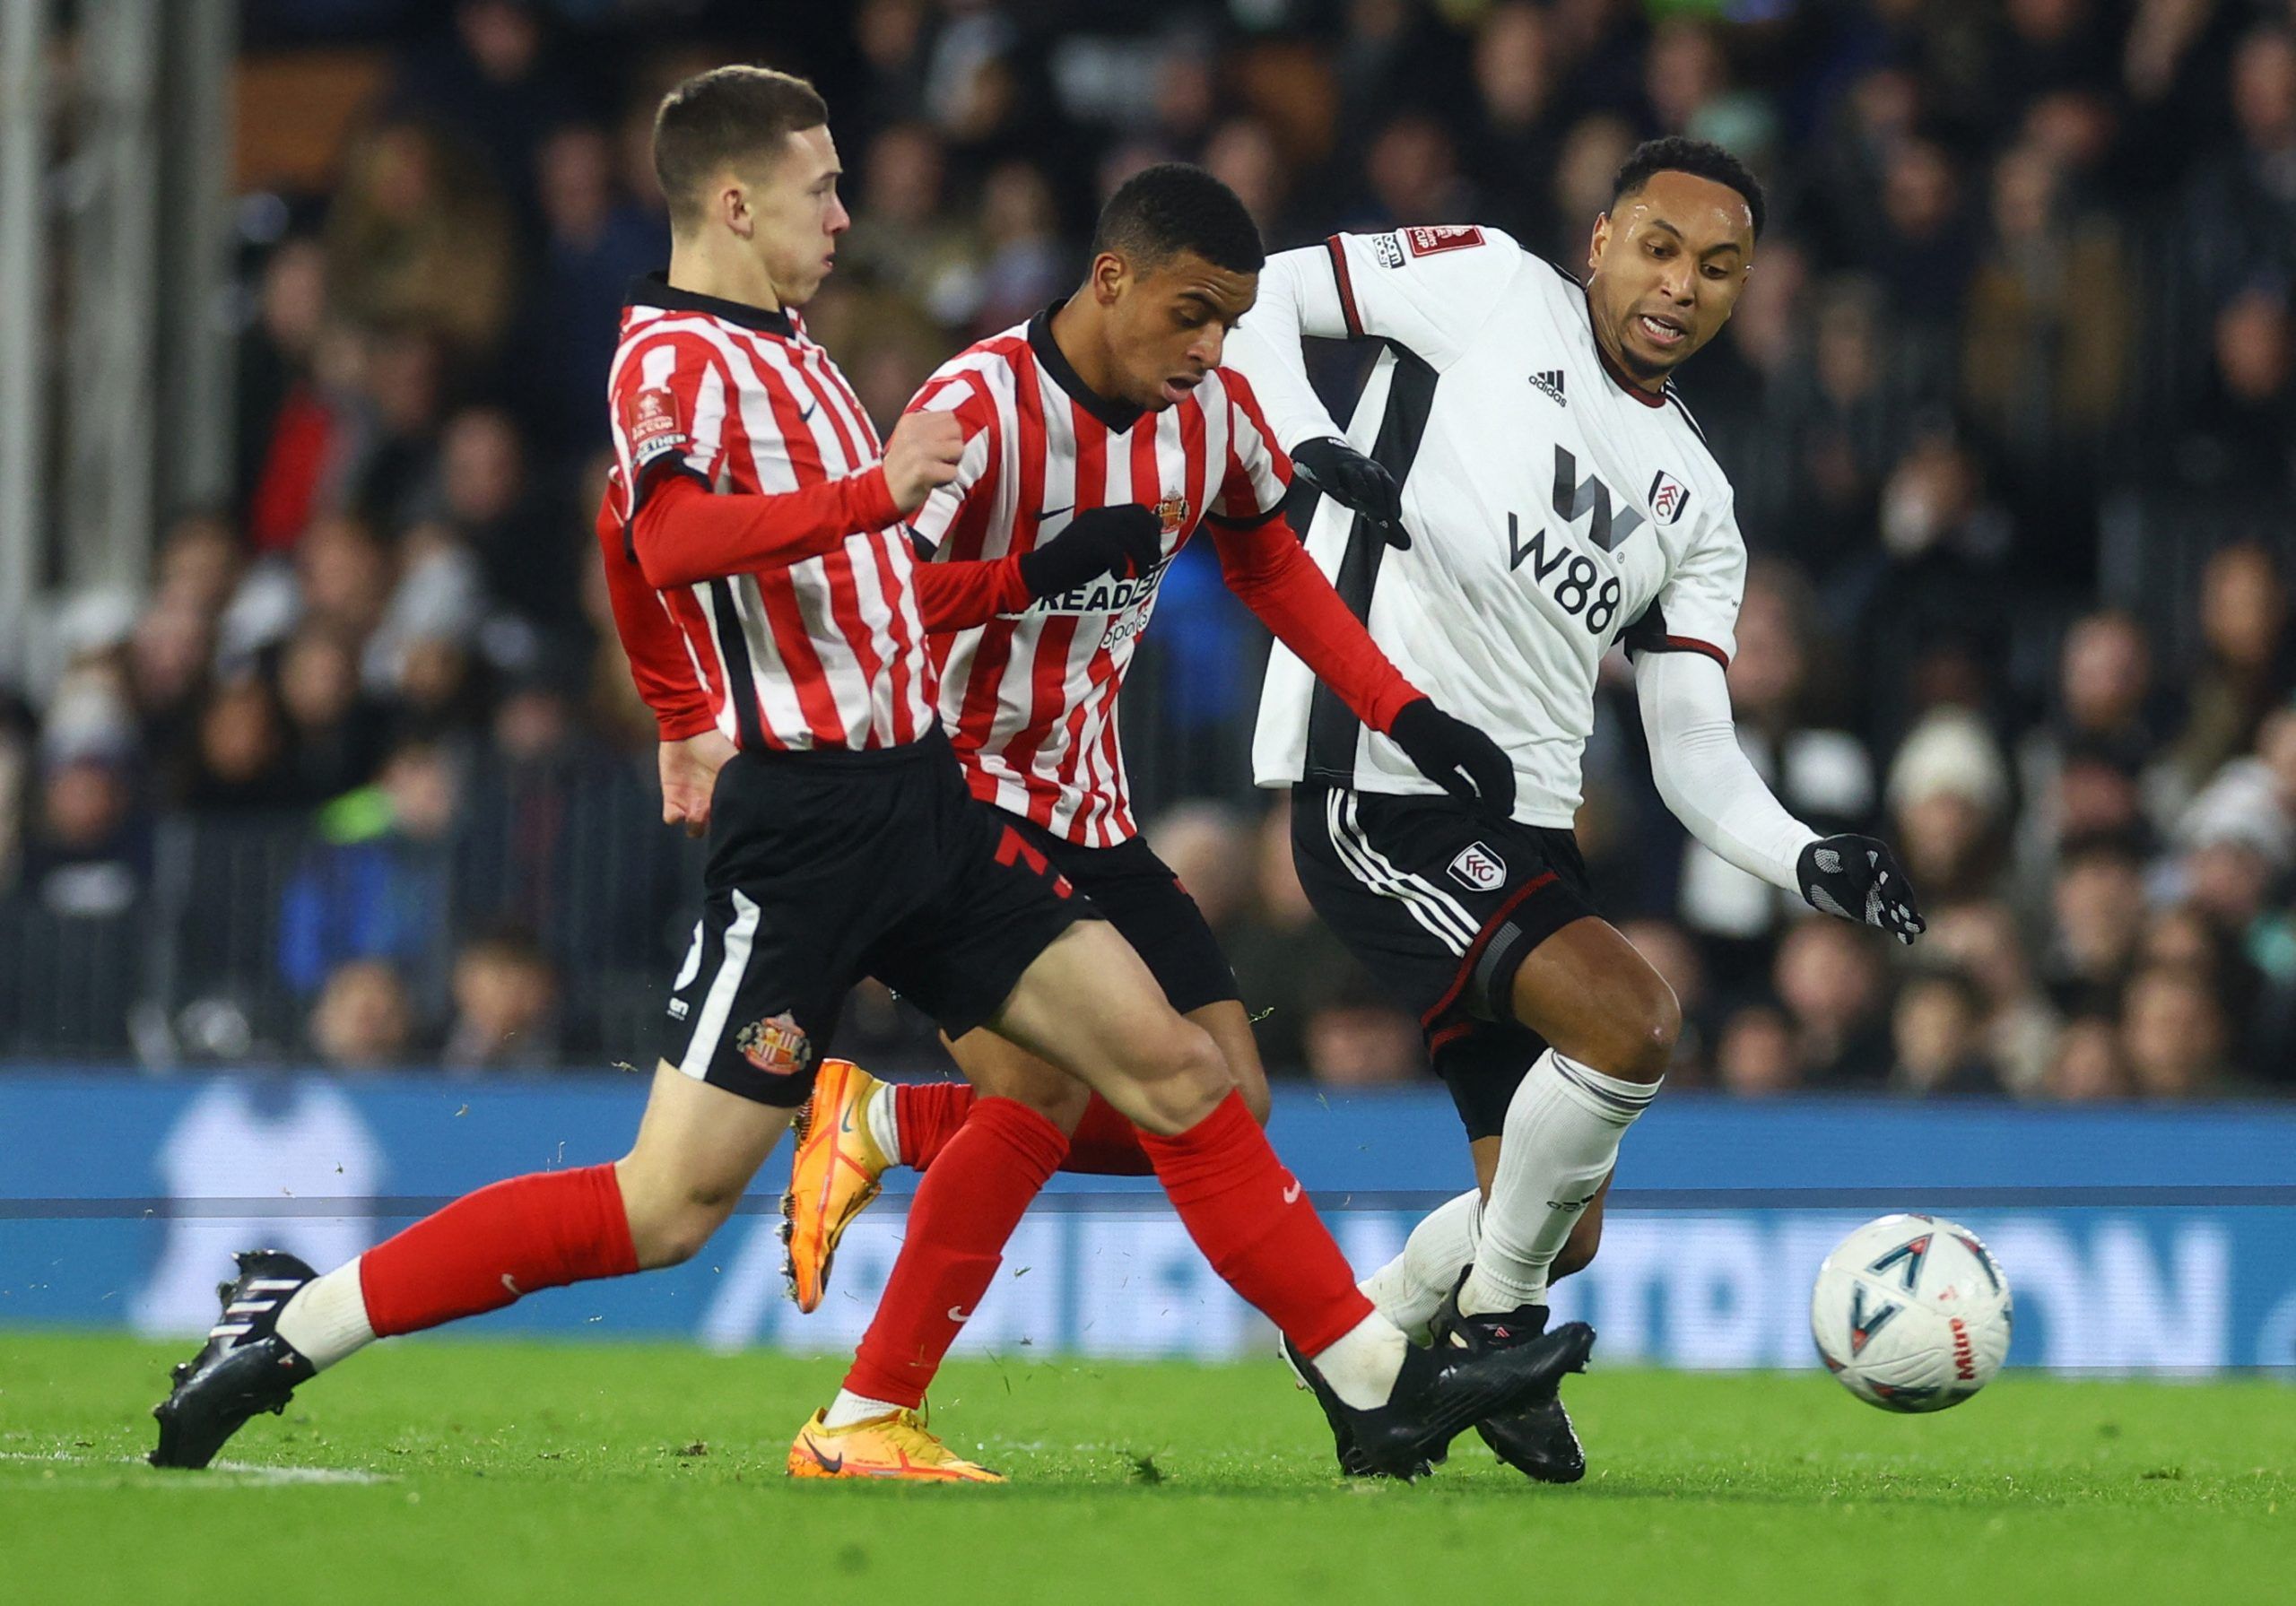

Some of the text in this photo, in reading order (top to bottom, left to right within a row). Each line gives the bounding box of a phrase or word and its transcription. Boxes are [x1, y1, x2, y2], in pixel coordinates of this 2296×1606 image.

[1384, 234, 1402, 265] oom
[1414, 229, 1429, 248] CUP
[1528, 375, 1568, 408] adidas
[1656, 484, 1679, 517] FFC
[1508, 511, 1622, 635] W88
[1465, 854, 1495, 881] FFC
